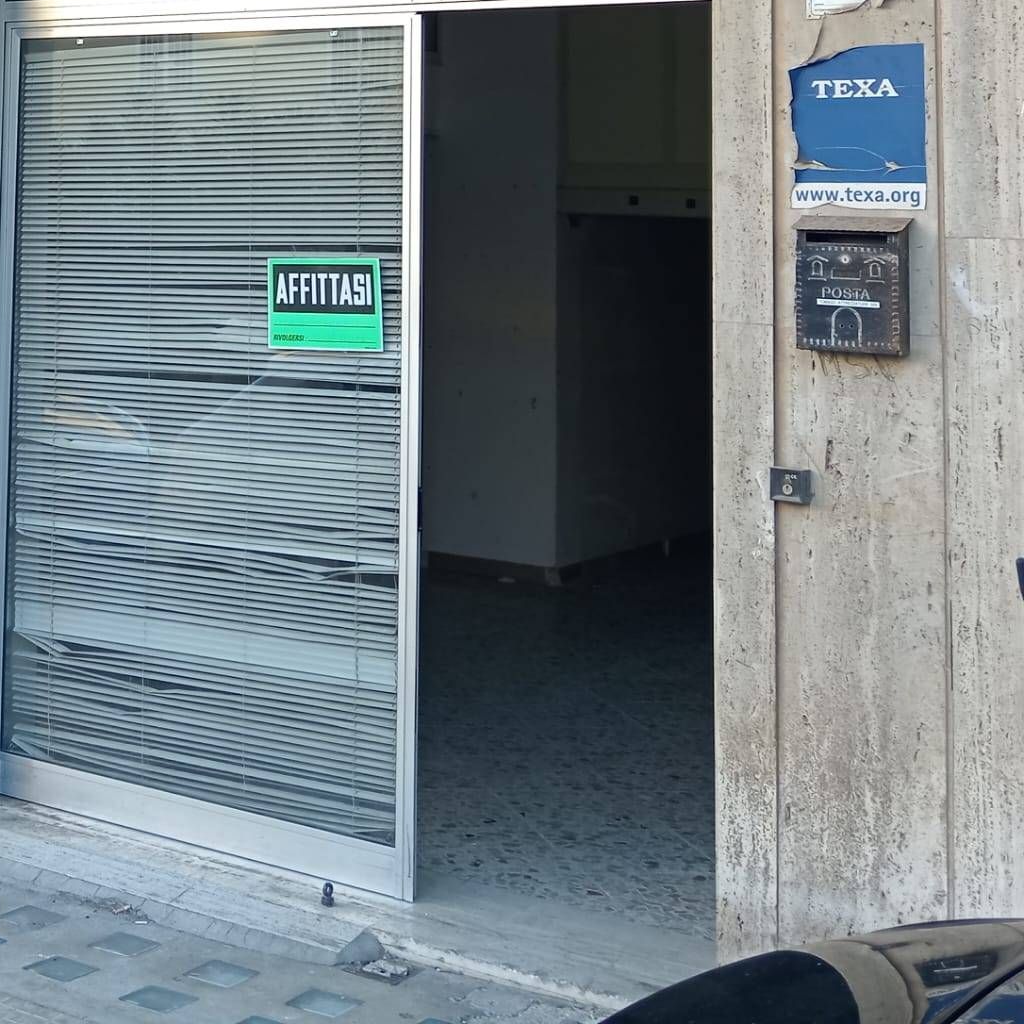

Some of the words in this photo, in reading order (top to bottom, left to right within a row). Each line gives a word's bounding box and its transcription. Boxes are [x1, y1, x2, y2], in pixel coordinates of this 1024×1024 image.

[811, 78, 899, 98] TEXA
[796, 187, 921, 207] www.texa.org
[276, 272, 373, 306] AFFITTASI
[820, 287, 870, 301] POSTA
